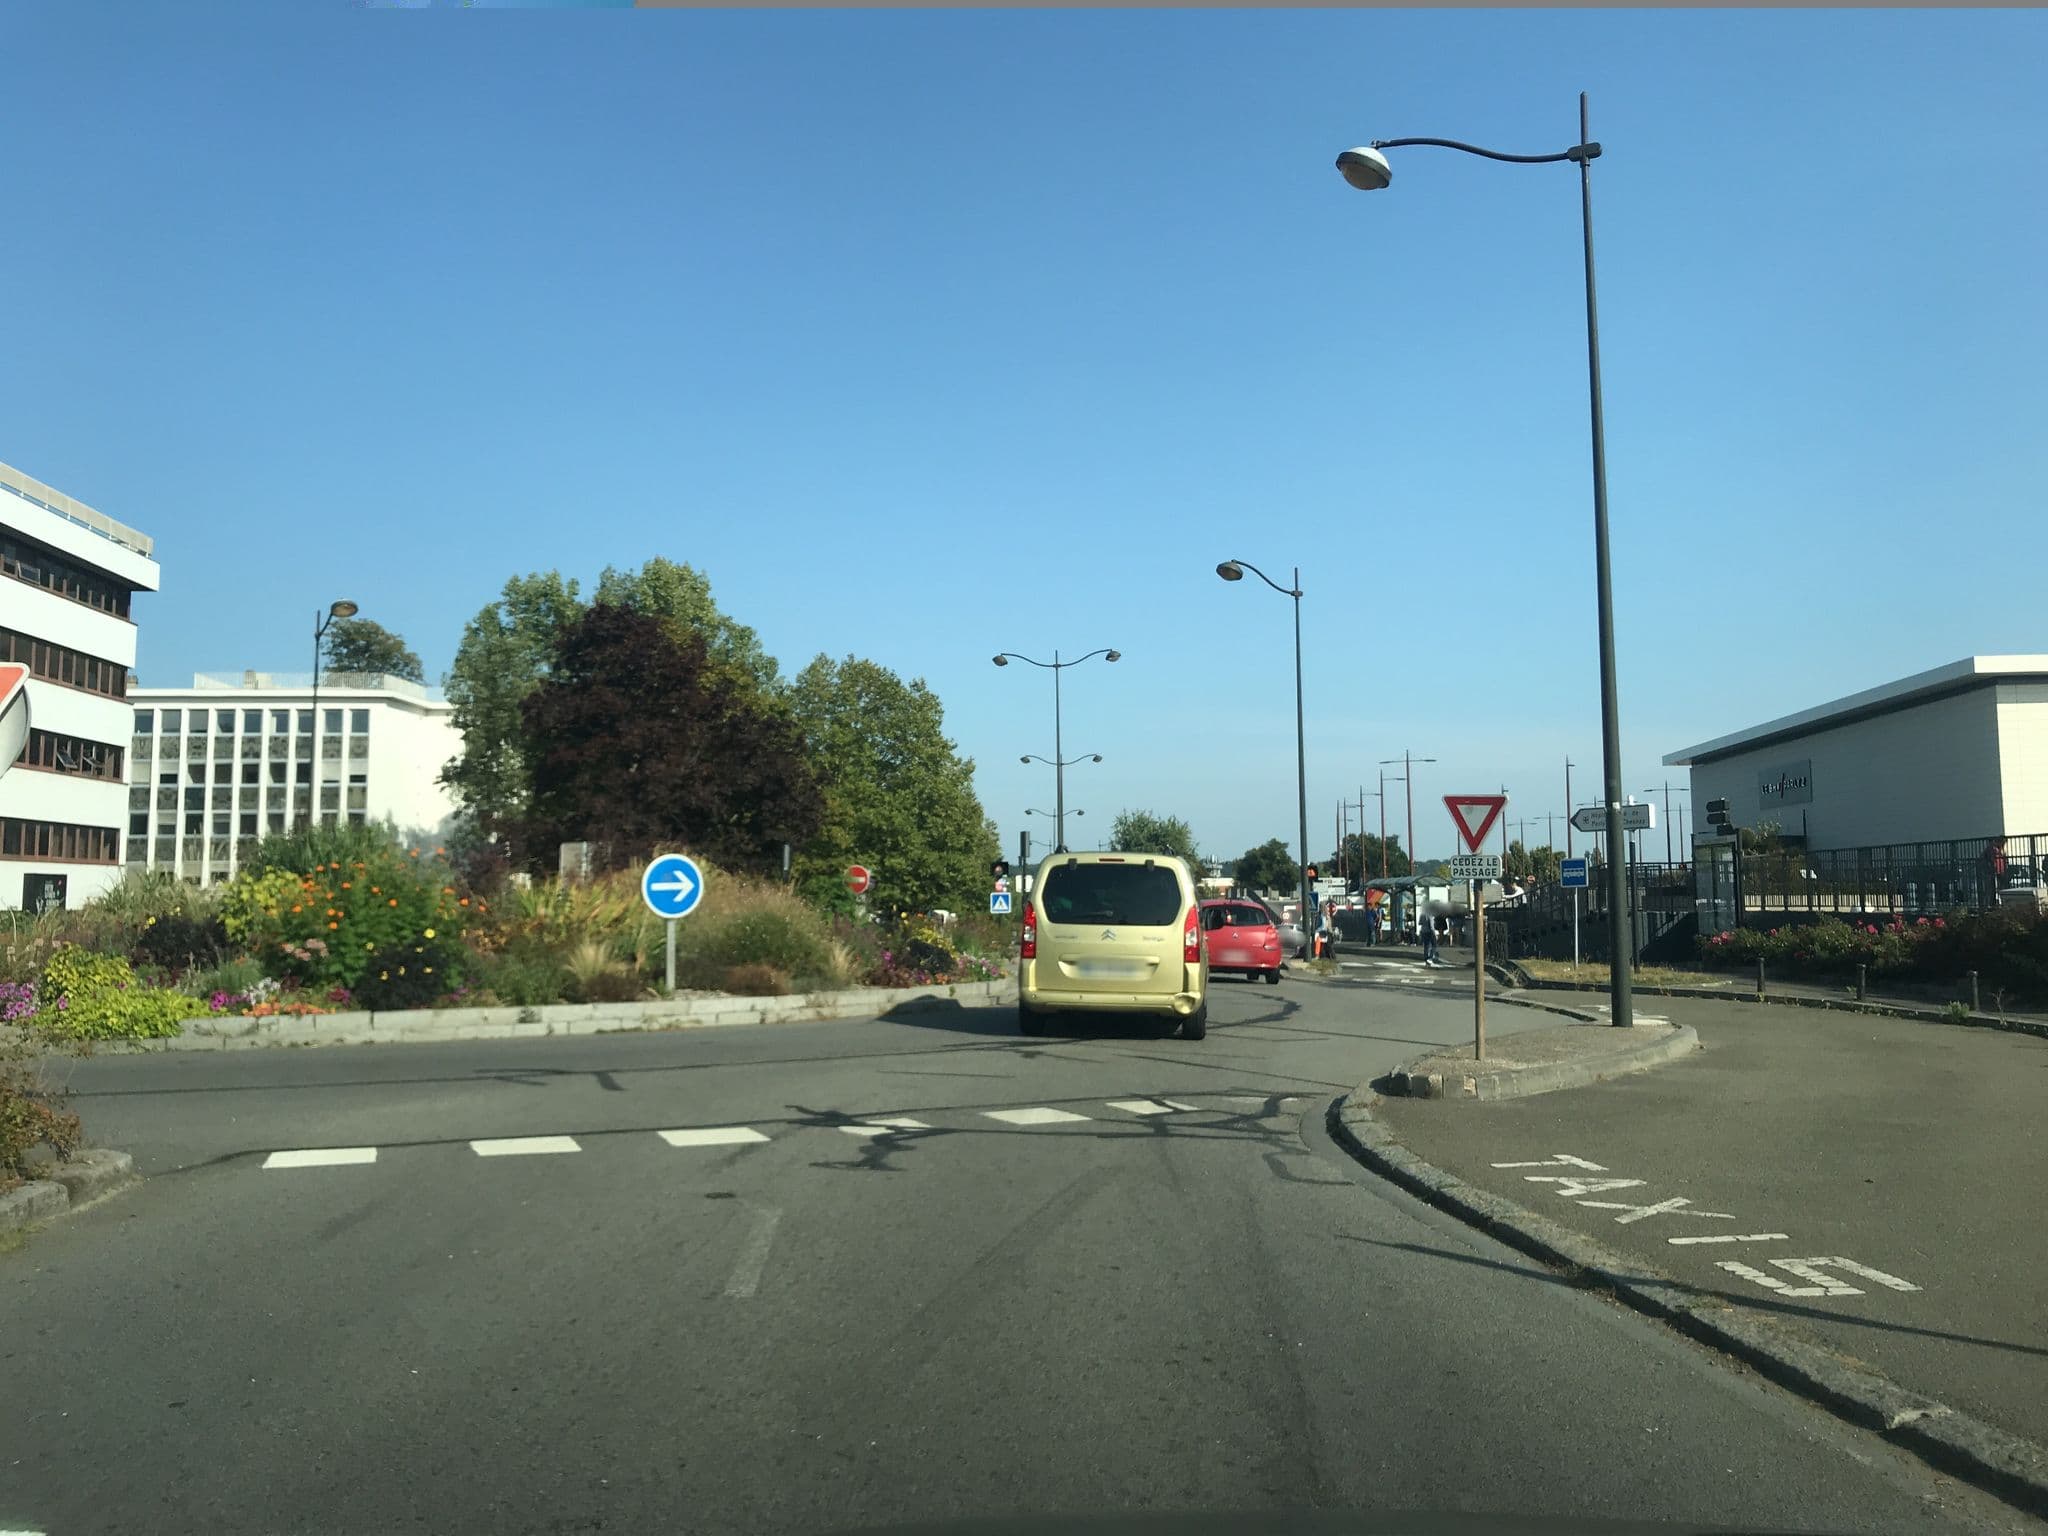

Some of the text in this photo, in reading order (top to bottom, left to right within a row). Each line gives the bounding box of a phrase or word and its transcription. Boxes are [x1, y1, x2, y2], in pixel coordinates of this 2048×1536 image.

[1452, 857, 1498, 867] CEDEZ LE
[1453, 868, 1497, 877] PASSAGE
[1489, 1153, 1924, 1297] TAXIS
